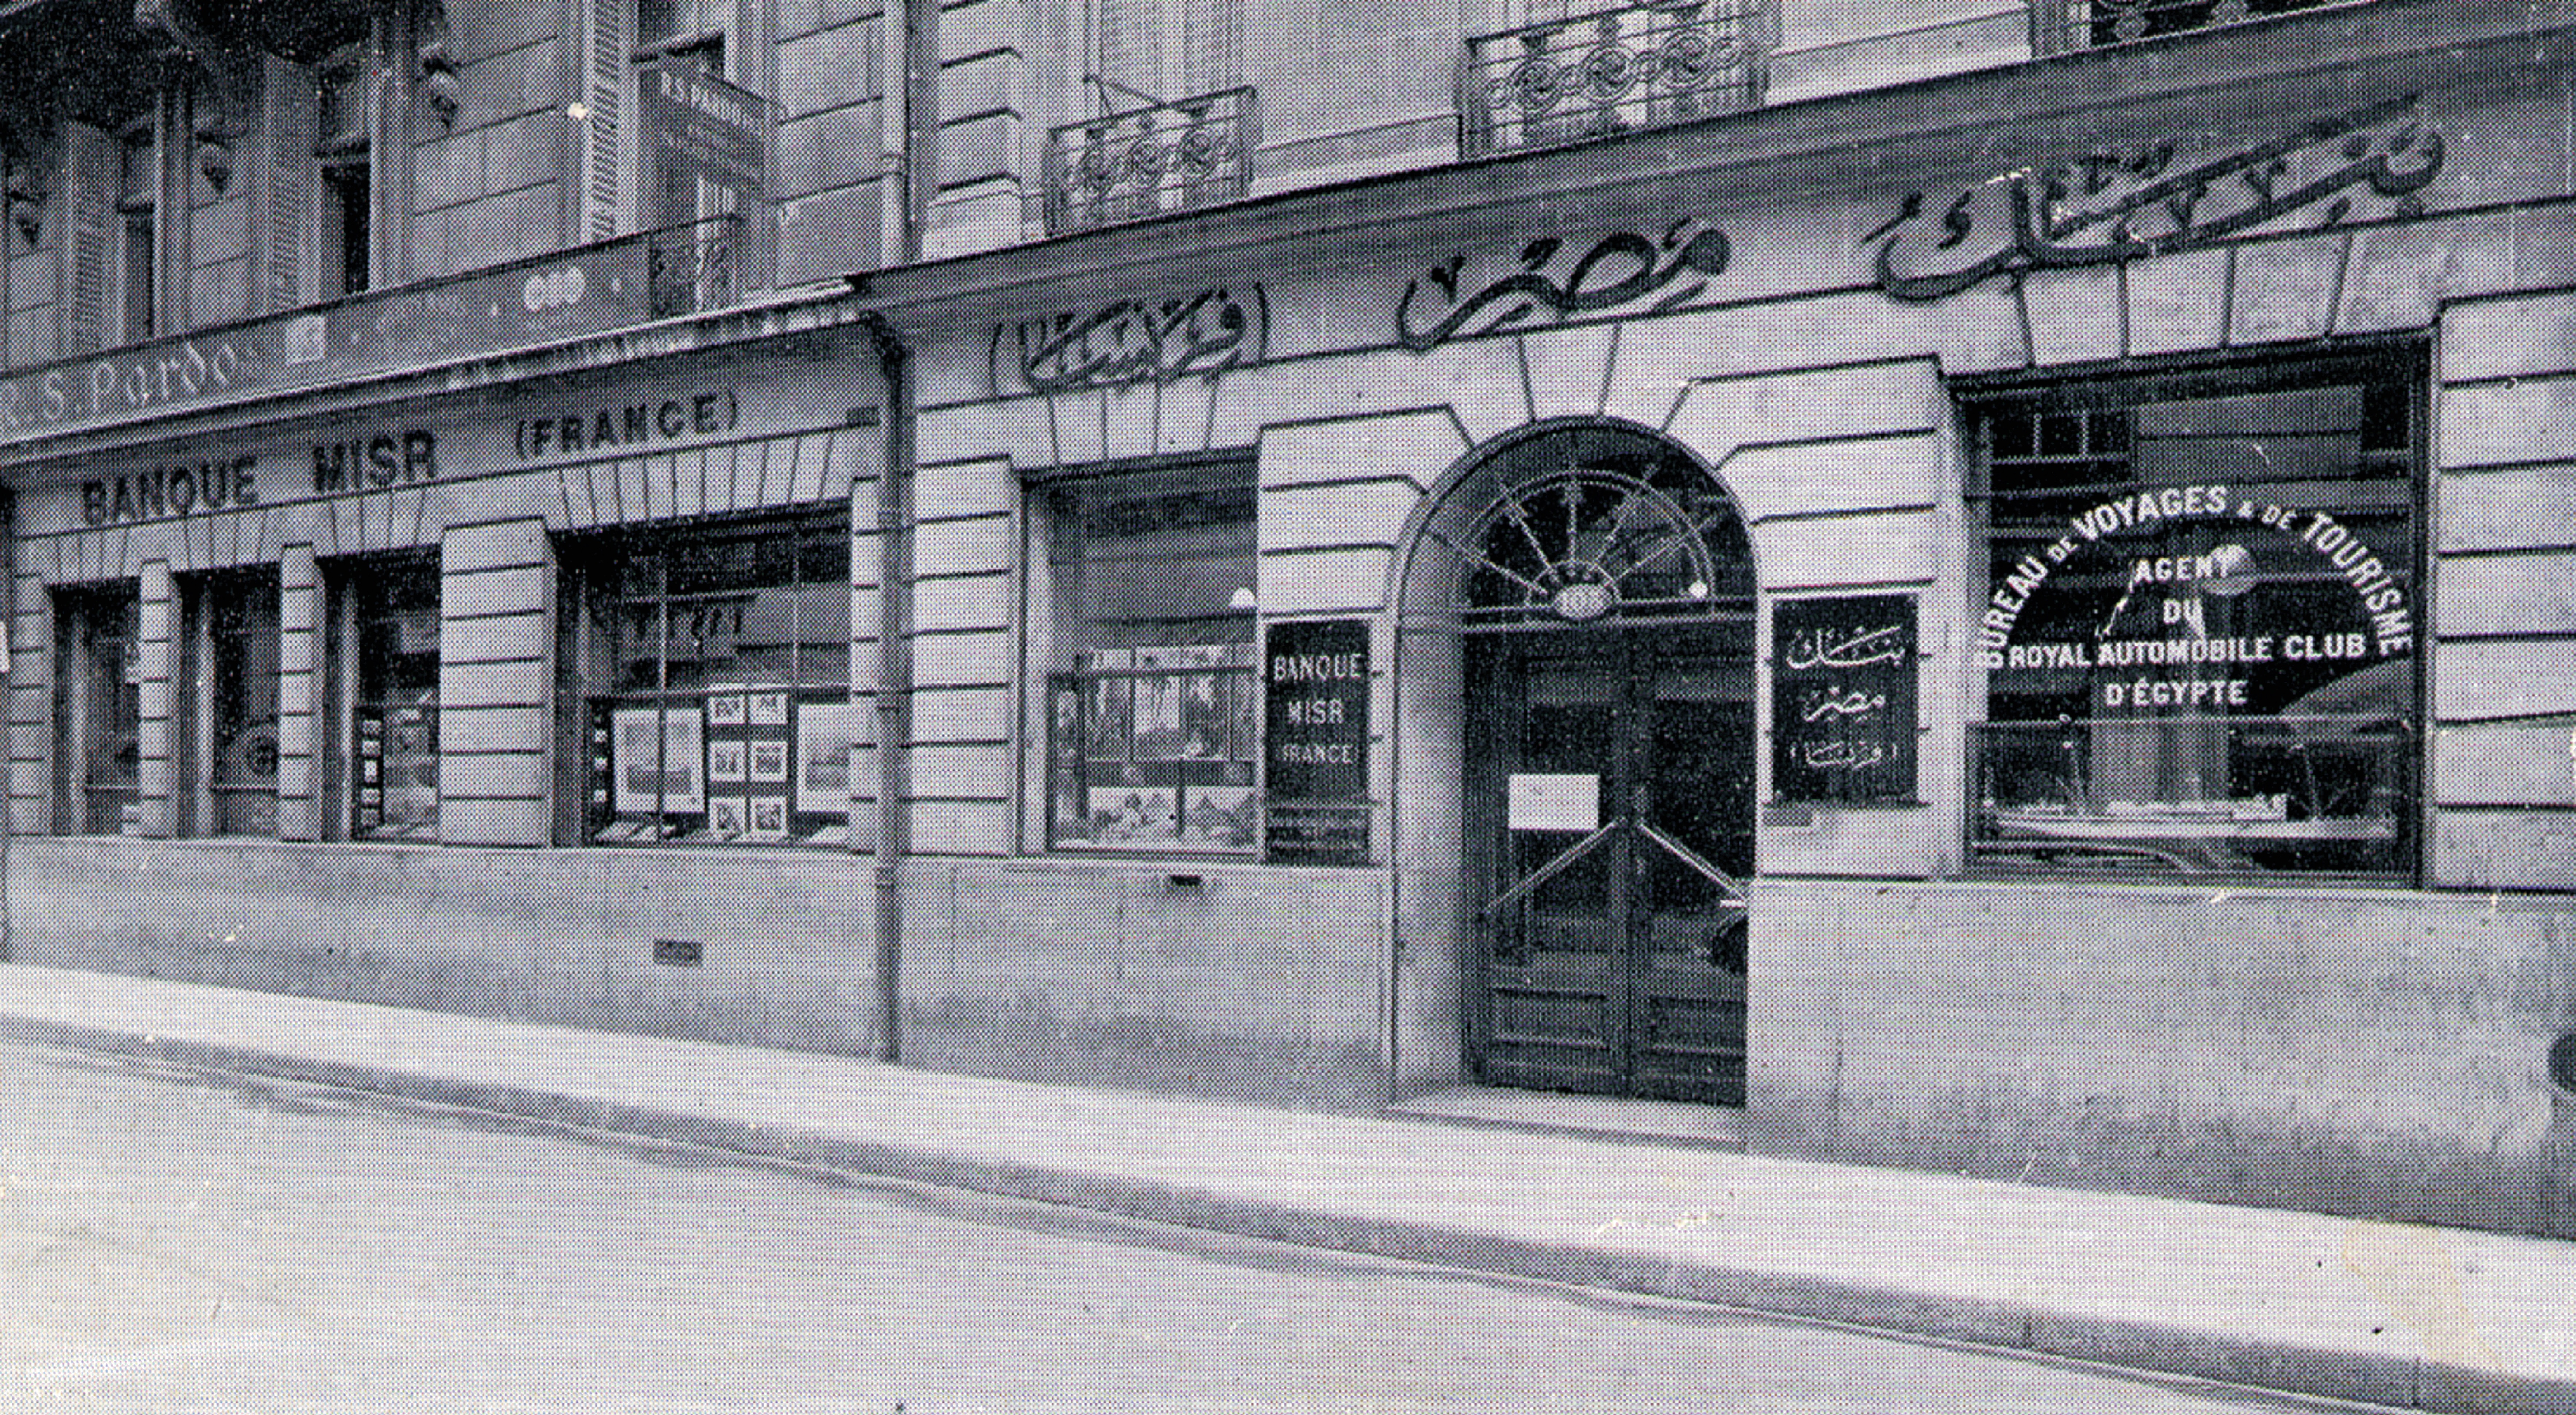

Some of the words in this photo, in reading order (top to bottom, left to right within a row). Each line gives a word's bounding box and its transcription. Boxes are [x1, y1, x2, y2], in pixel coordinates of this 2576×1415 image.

[1861, 94, 2445, 302] بنك
[1396, 216, 1731, 354] مصر
[82, 455, 259, 525] BANQUE
[312, 430, 438, 493] MISR
[515, 388, 738, 460] (FRANCE)
[1972, 554, 2049, 669] BUREAU
[2046, 534, 2079, 563] DE
[2071, 484, 2228, 541] VOYAGES
[2237, 499, 2253, 519] &
[2261, 504, 2297, 530] DE
[2301, 511, 2414, 656] TOURISME
[2133, 554, 2231, 584] AGENT
[2162, 597, 2203, 624] DU
[1273, 651, 1363, 681] BANQUE
[1786, 624, 1905, 670] بنك
[2009, 643, 2091, 669] ROYAL
[2097, 635, 2274, 667] AUTOMOBILE
[2284, 632, 2367, 661] CLUB
[1799, 685, 1886, 724] مصر
[2105, 675, 2248, 706] D'ÉGYPTE
[1287, 697, 1344, 725] MISR
